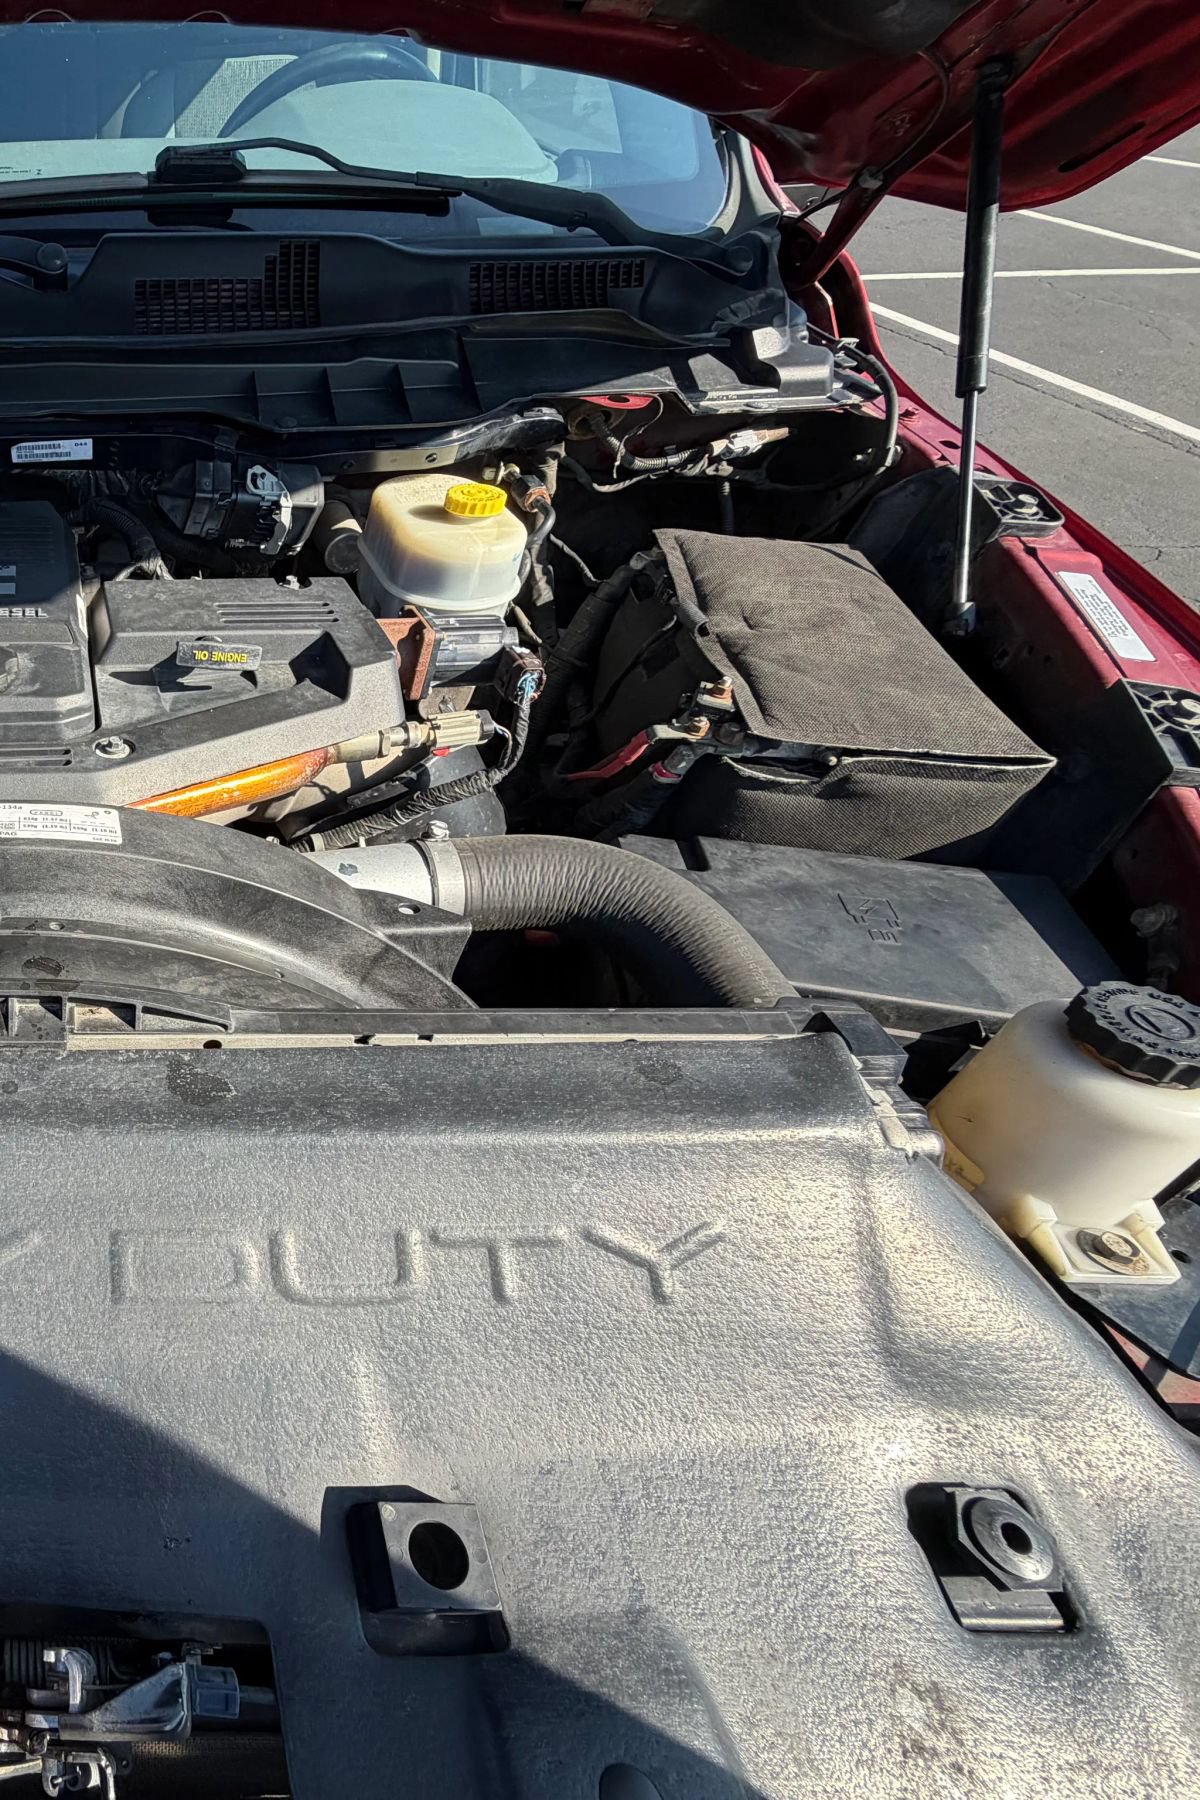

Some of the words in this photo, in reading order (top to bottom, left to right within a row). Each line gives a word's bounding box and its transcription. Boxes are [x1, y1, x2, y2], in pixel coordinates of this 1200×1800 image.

[193, 650, 209, 660] OIL
[211, 651, 247, 663] ENGINE
[109, 1219, 727, 1304] DUTY
